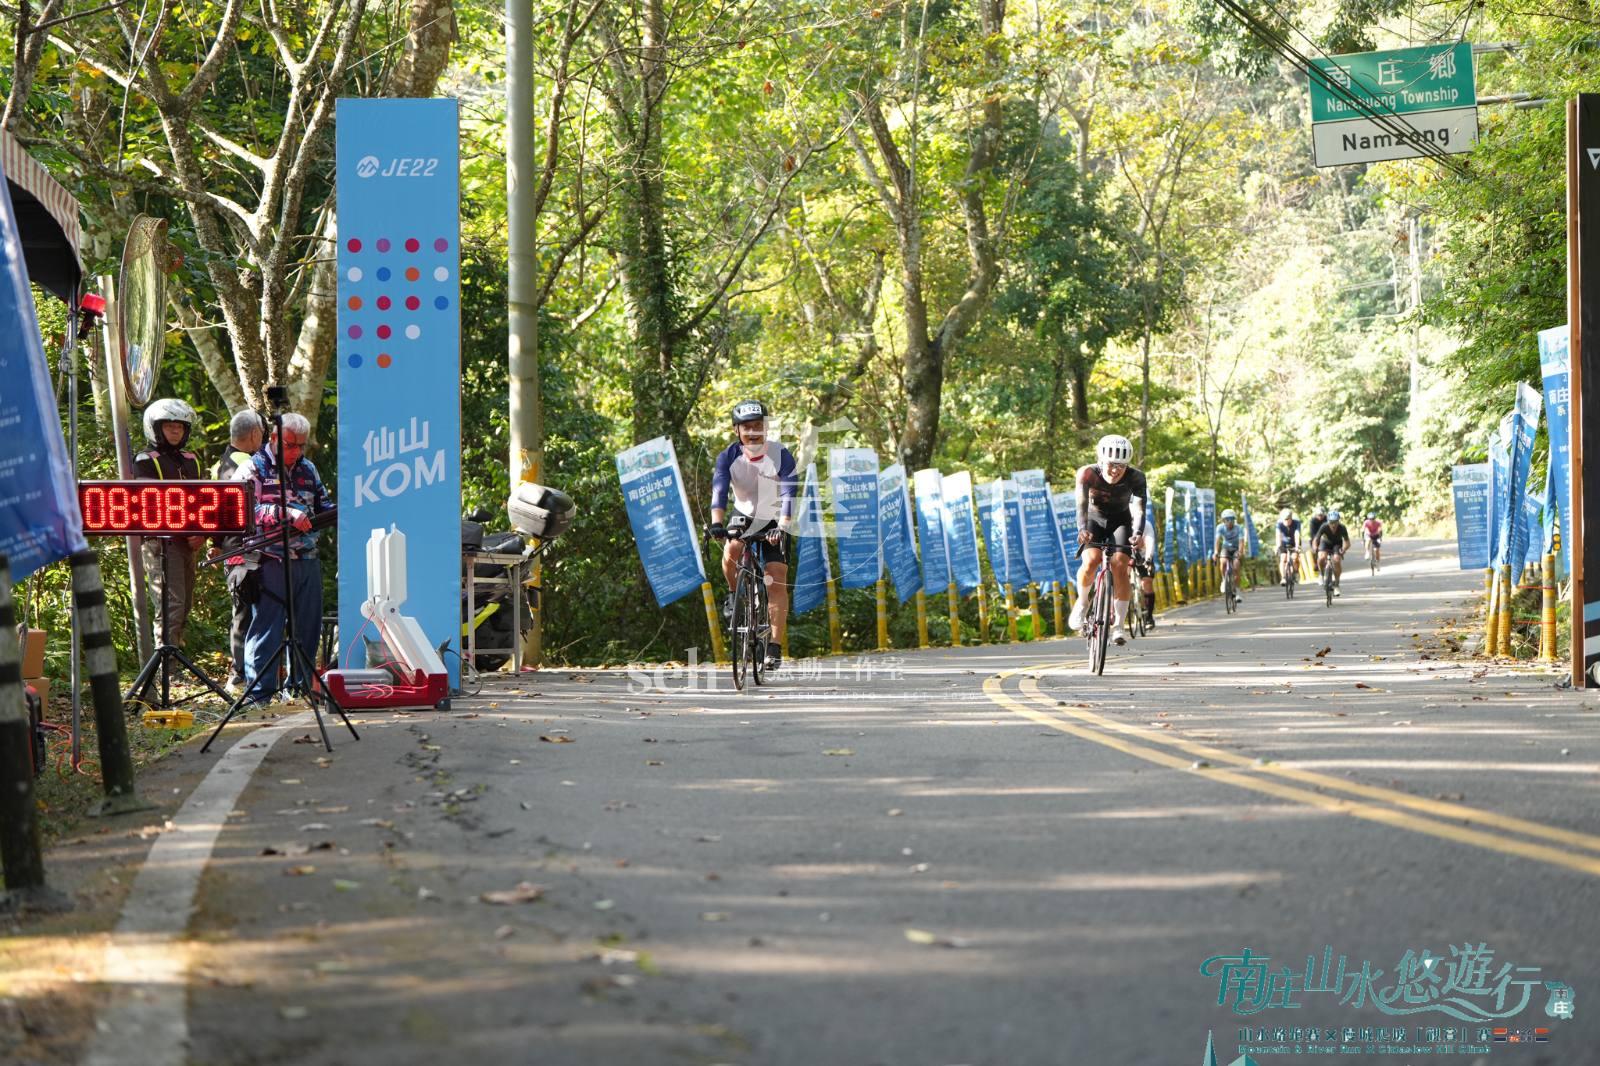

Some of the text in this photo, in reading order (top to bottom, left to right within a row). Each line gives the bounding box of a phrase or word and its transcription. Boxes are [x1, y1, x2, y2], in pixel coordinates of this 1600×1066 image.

[1323, 51, 1457, 91] 南庄鄉
[1402, 86, 1459, 105] Township
[1342, 127, 1450, 151] Namzong
[382, 158, 438, 177] JE22
[362, 416, 429, 466] 仙山
[354, 448, 446, 508] KOM
[84, 487, 244, 529] 08:08:27
